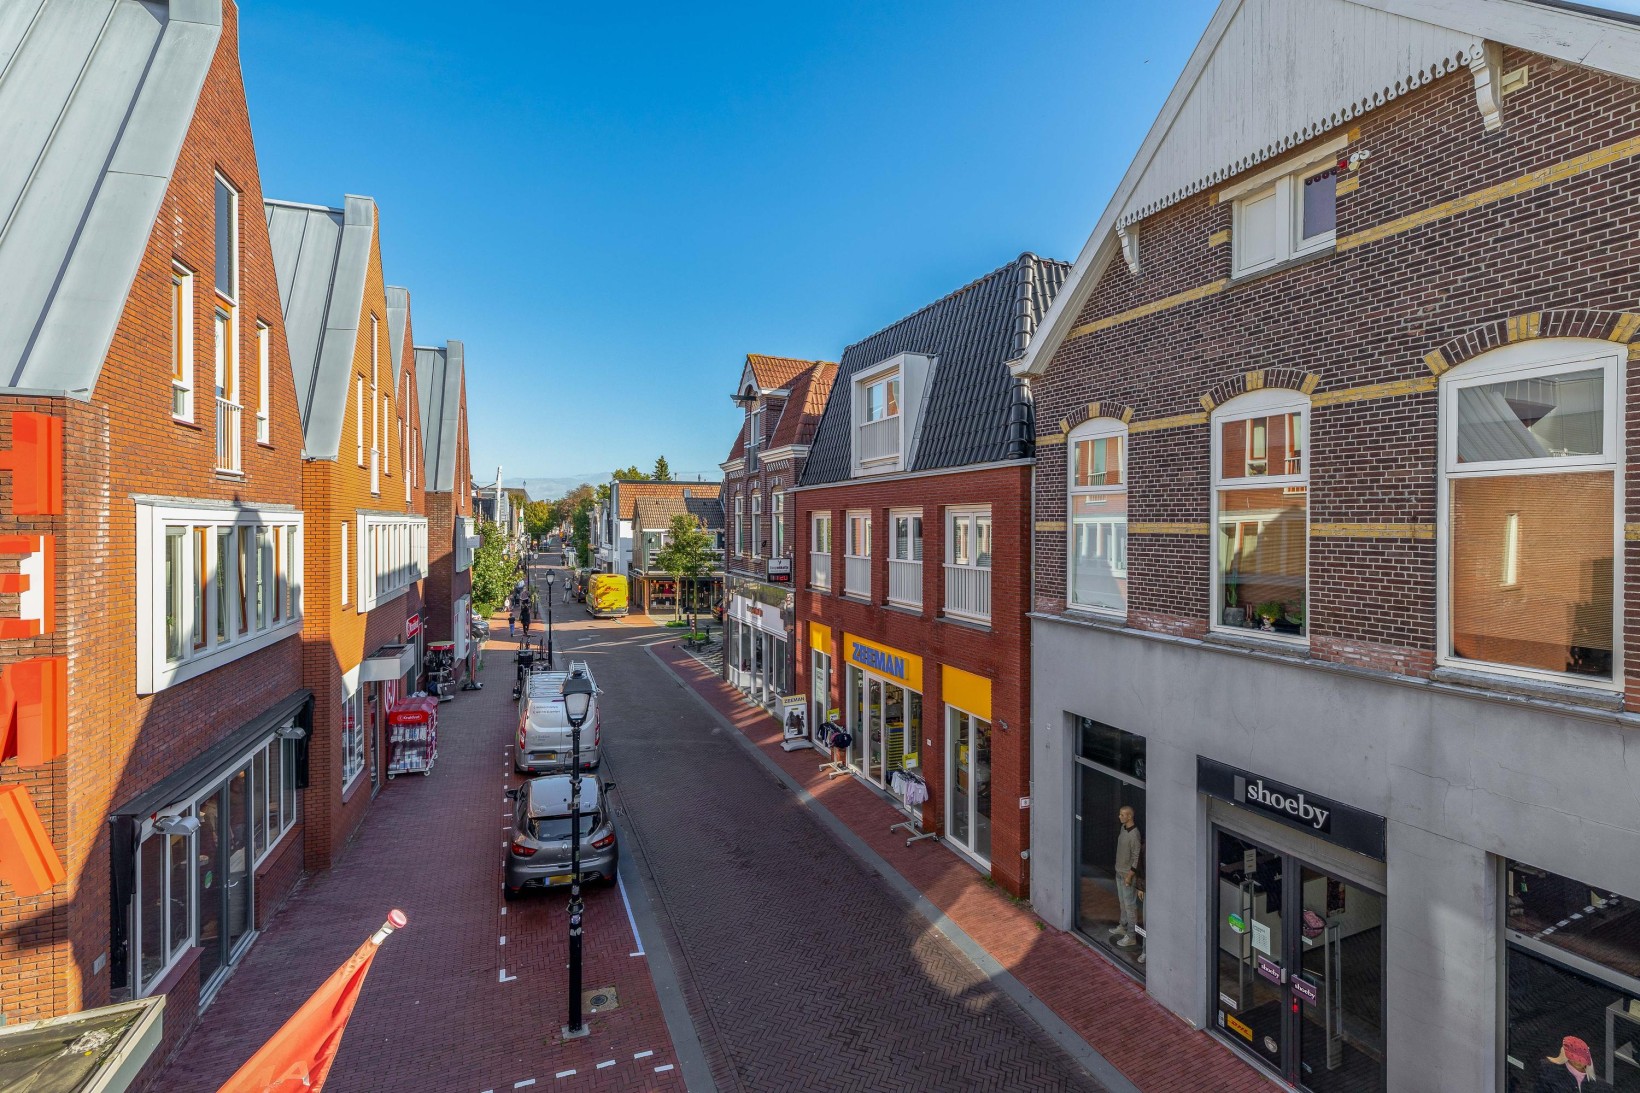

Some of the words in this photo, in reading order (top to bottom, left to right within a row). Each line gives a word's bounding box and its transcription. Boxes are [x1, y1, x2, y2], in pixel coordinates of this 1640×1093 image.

[852, 642, 905, 680] ZEEMAN
[1247, 780, 1329, 829] shoeby
[1261, 964, 1280, 979] shoeby
[1294, 984, 1316, 1000] shoeby
